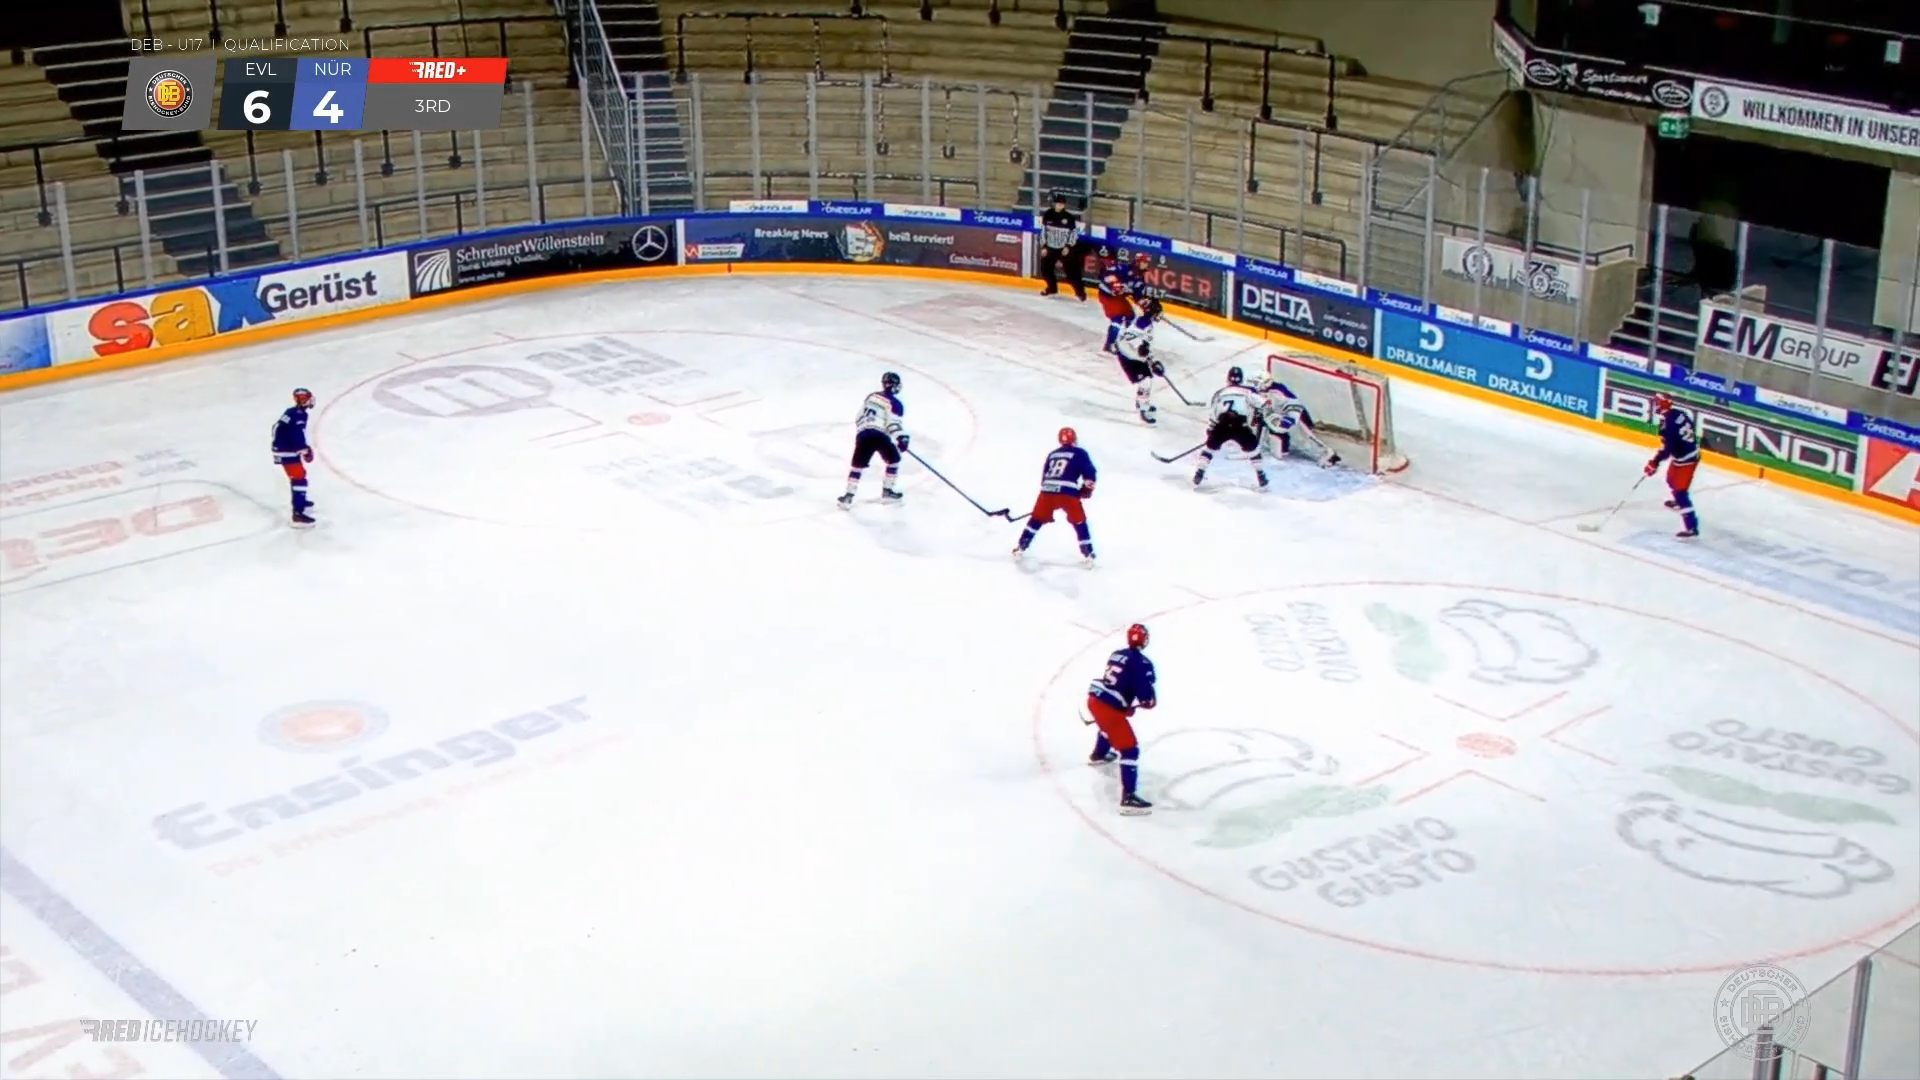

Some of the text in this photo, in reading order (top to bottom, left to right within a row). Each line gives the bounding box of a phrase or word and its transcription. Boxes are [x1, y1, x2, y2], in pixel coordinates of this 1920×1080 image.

[1743, 99, 1844, 135] WILLKOMMEN
[1848, 117, 1864, 136] IN
[754, 227, 830, 241] Breaking News
[87, 270, 378, 357] sax Gerüst
[1242, 283, 1315, 326] DELTA
[1703, 308, 1861, 369] EM GROUP
[150, 694, 592, 851] Ensinger
[1247, 816, 1457, 892] GUSTAVO
[1316, 847, 1476, 908] GUSTO
